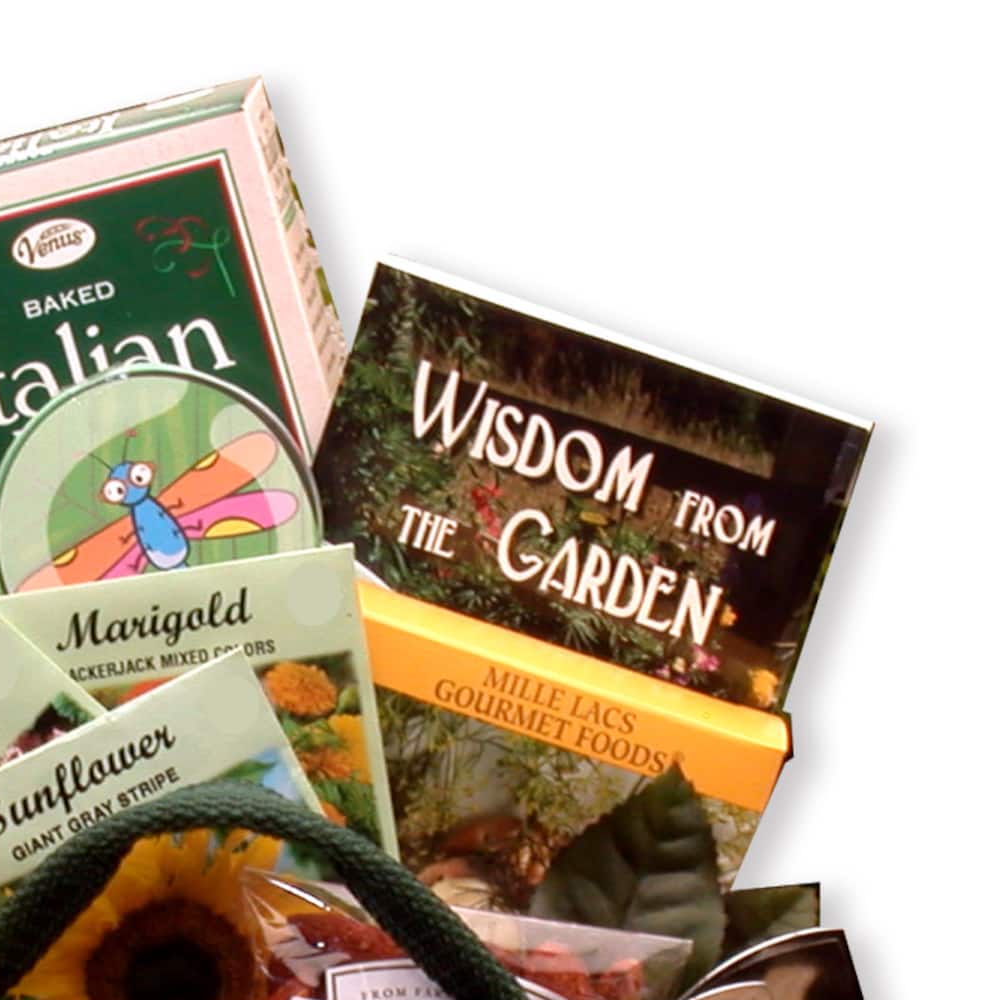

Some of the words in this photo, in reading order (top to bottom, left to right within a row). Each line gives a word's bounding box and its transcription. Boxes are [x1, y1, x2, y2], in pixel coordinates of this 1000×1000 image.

[18, 230, 83, 264] Venus
[23, 281, 115, 318] BAKED
[412, 360, 654, 512] WISDOM
[675, 489, 777, 557] FROM
[398, 505, 459, 559] THE
[497, 509, 723, 647] GARDEN
[57, 587, 252, 651] Marigold
[70, 657, 156, 682] ACKERJACK
[161, 648, 209, 669] MIXED
[214, 639, 276, 660] CORS
[435, 679, 572, 741] GOURMET
[576, 726, 667, 774] FOODS
[483, 666, 567, 711] MILLE
[571, 695, 637, 735] LACS
[12, 825, 65, 862] GIANT
[67, 801, 114, 832] GRAY
[117, 766, 181, 808] STRIPE
[360, 986, 407, 1000] FROM
